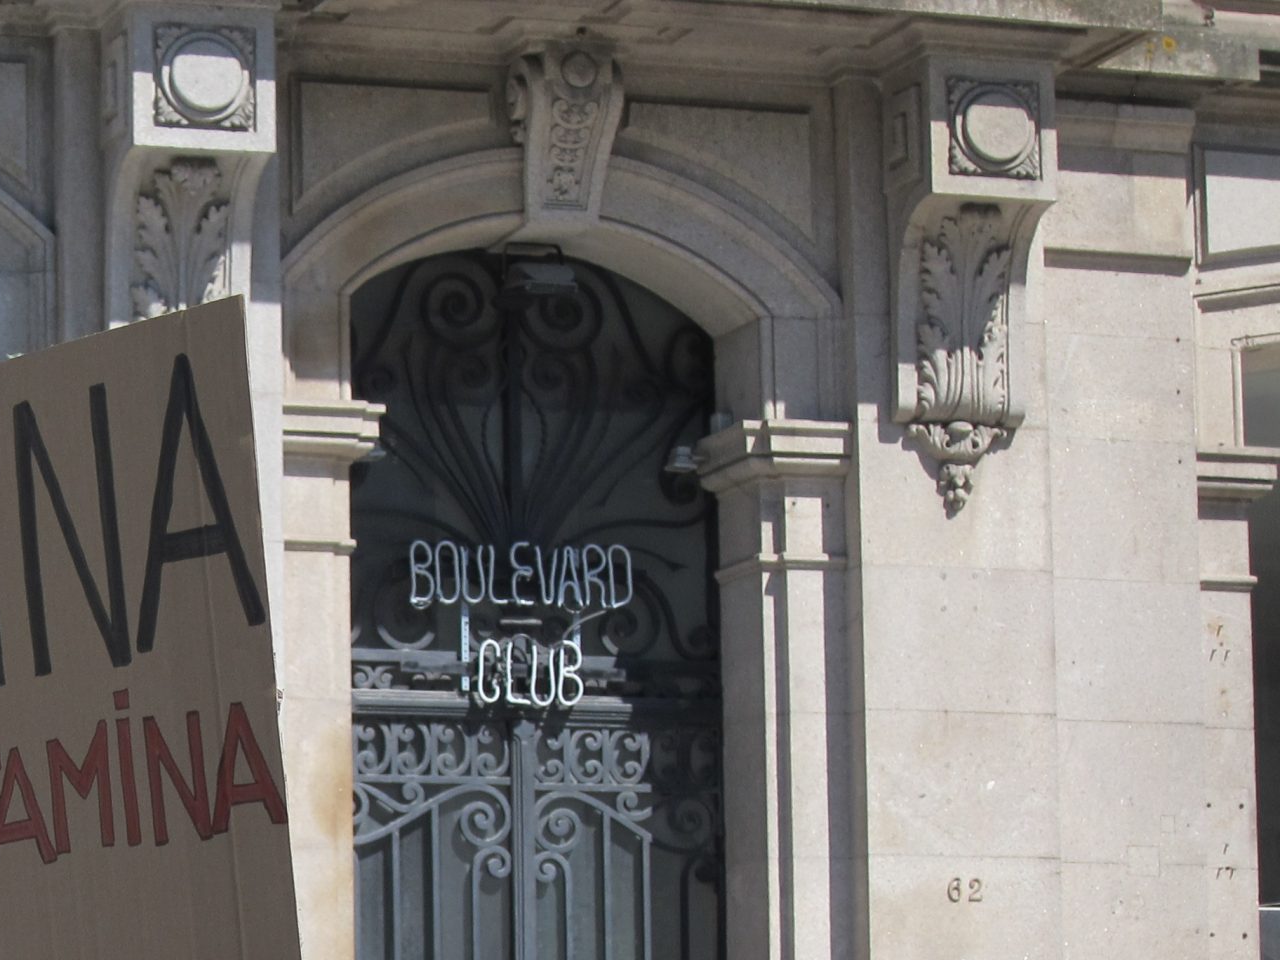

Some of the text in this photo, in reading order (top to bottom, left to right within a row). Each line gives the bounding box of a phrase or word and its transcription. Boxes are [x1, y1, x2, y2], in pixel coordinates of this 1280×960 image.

[409, 539, 634, 609] BOULEVARD
[477, 638, 585, 706] CLUB
[946, 876, 984, 903] 62
